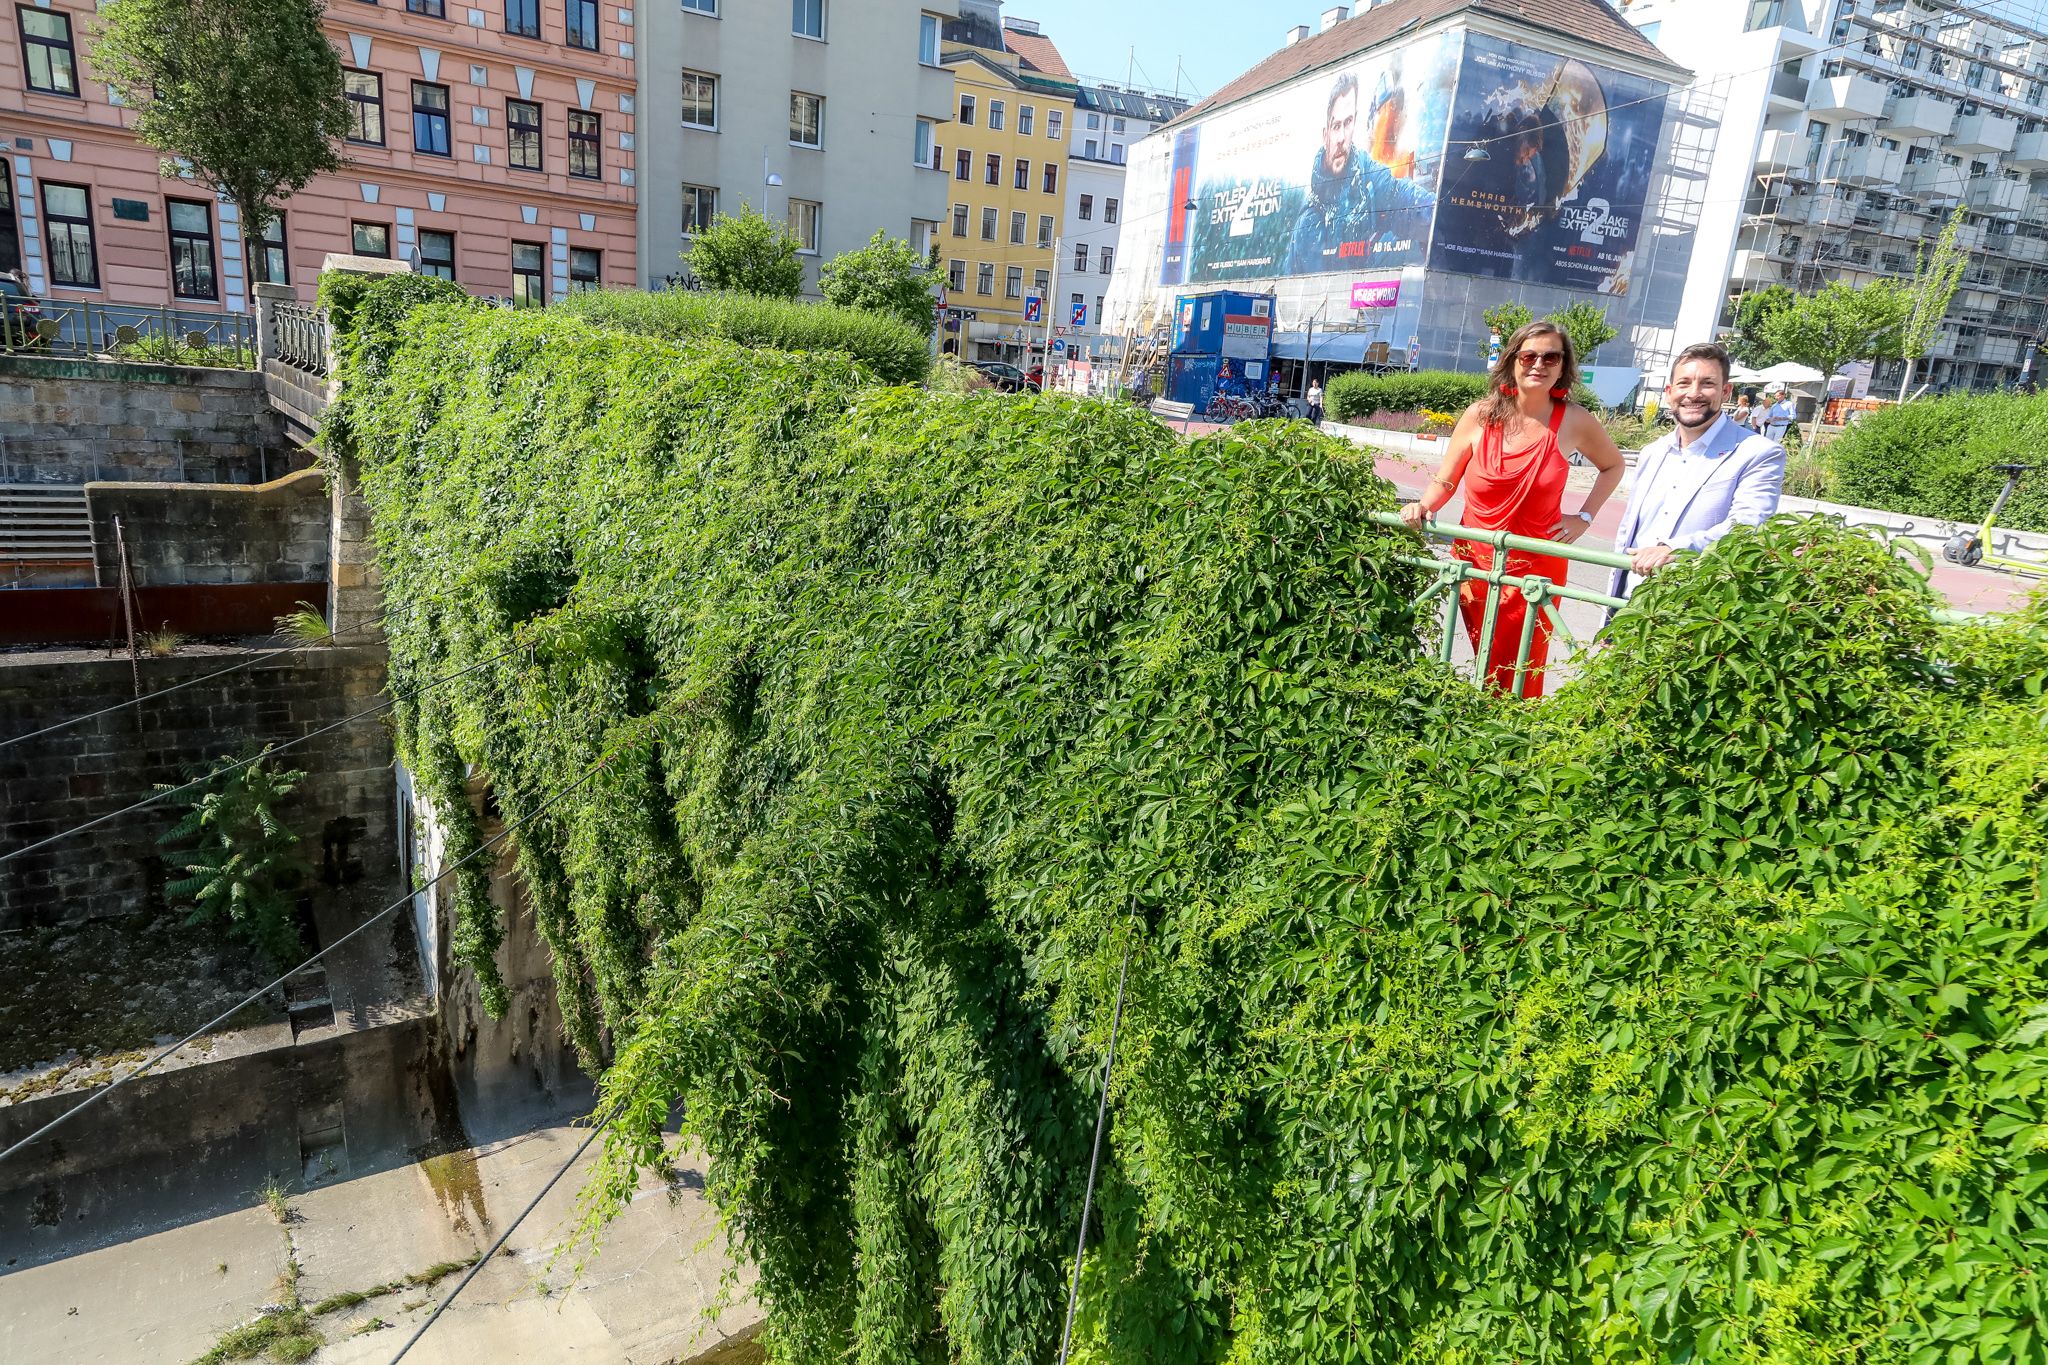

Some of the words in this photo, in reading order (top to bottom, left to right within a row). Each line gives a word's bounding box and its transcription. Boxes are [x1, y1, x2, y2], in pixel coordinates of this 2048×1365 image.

[1474, 55, 1487, 64] JOE
[1496, 61, 1526, 74] ANTHONY
[1526, 69, 1546, 79] RUSSO
[1215, 186, 1247, 209] TYLER
[1471, 190, 1506, 203] CHRIS
[1450, 196, 1522, 215] HEMSWORTH
[1563, 206, 1598, 222] TYLER
[1603, 215, 1630, 229] AKE
[1339, 240, 1365, 258] NETFLIX
[1372, 242, 1383, 253] AB
[1383, 241, 1393, 252] 16.
[1393, 240, 1412, 252] JUNI
[1456, 245, 1477, 254] RUSSO
[1568, 244, 1593, 257] NETFLIX
[1597, 252, 1605, 260] AB
[1353, 287, 1397, 303] WERBEWAND
[1227, 323, 1267, 335] HUBER
